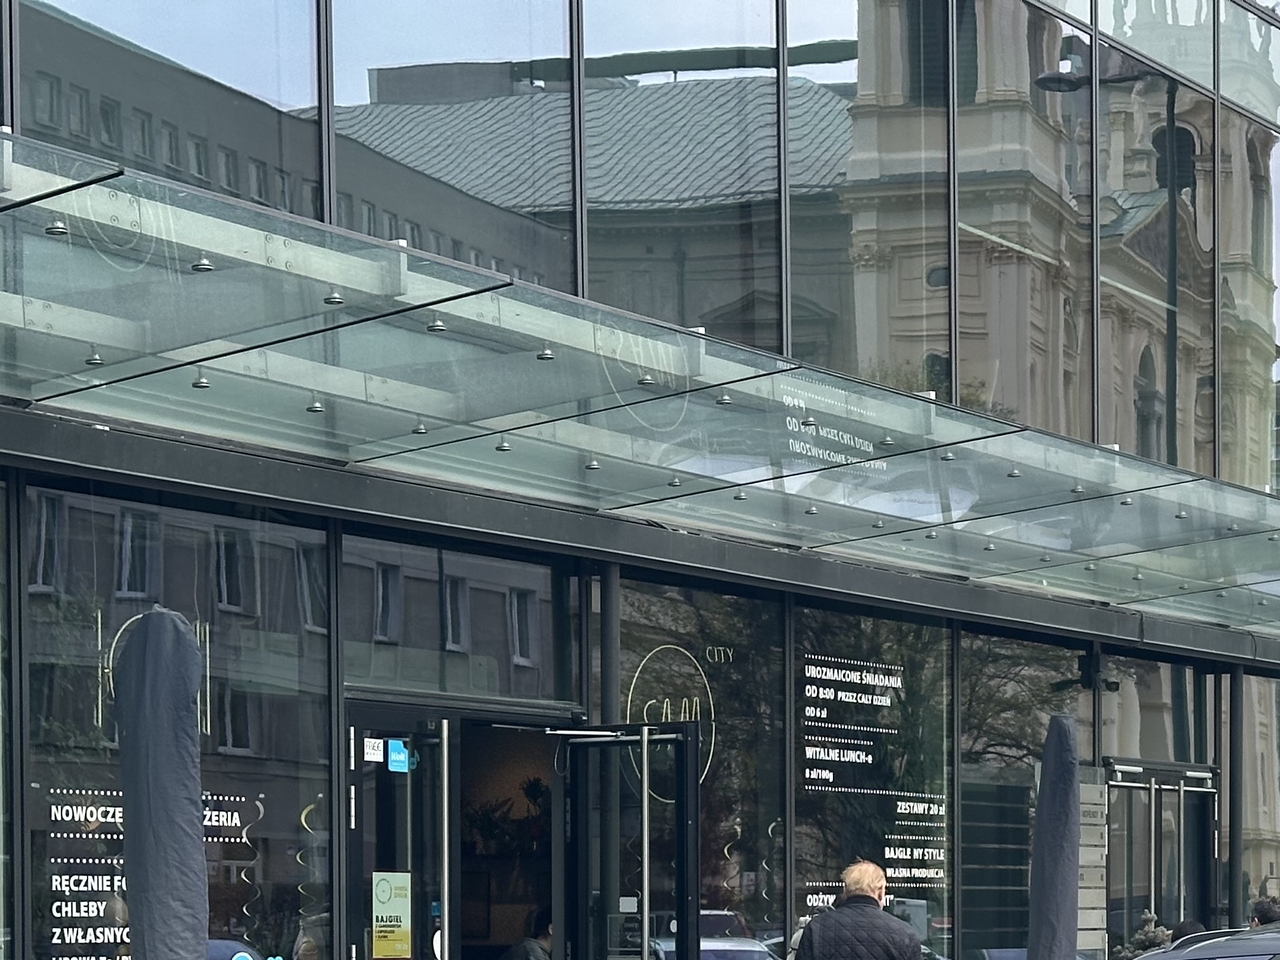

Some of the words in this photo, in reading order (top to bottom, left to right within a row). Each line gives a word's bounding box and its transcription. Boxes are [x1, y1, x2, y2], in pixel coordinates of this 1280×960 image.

[706, 646, 734, 663] CITY
[862, 670, 902, 688] ŚNIADANIA
[805, 685, 818, 697] OD
[819, 688, 834, 700] 8:00
[837, 691, 857, 703] PRZEZ
[805, 706, 815, 717] OD
[816, 709, 820, 718] 6
[805, 747, 839, 761] WITALNE
[841, 750, 873, 764] LUNCH-e
[897, 801, 929, 814] ZESTAWY
[930, 804, 939, 815] 20
[885, 847, 912, 859] BAJGLE
[913, 848, 924, 860] NY
[924, 849, 945, 861] STYLE
[52, 875, 111, 895] RĘCZNIE
[52, 901, 106, 917] CHLEBY
[376, 915, 402, 923] BAJGIEL
[52, 928, 62, 943] Z
